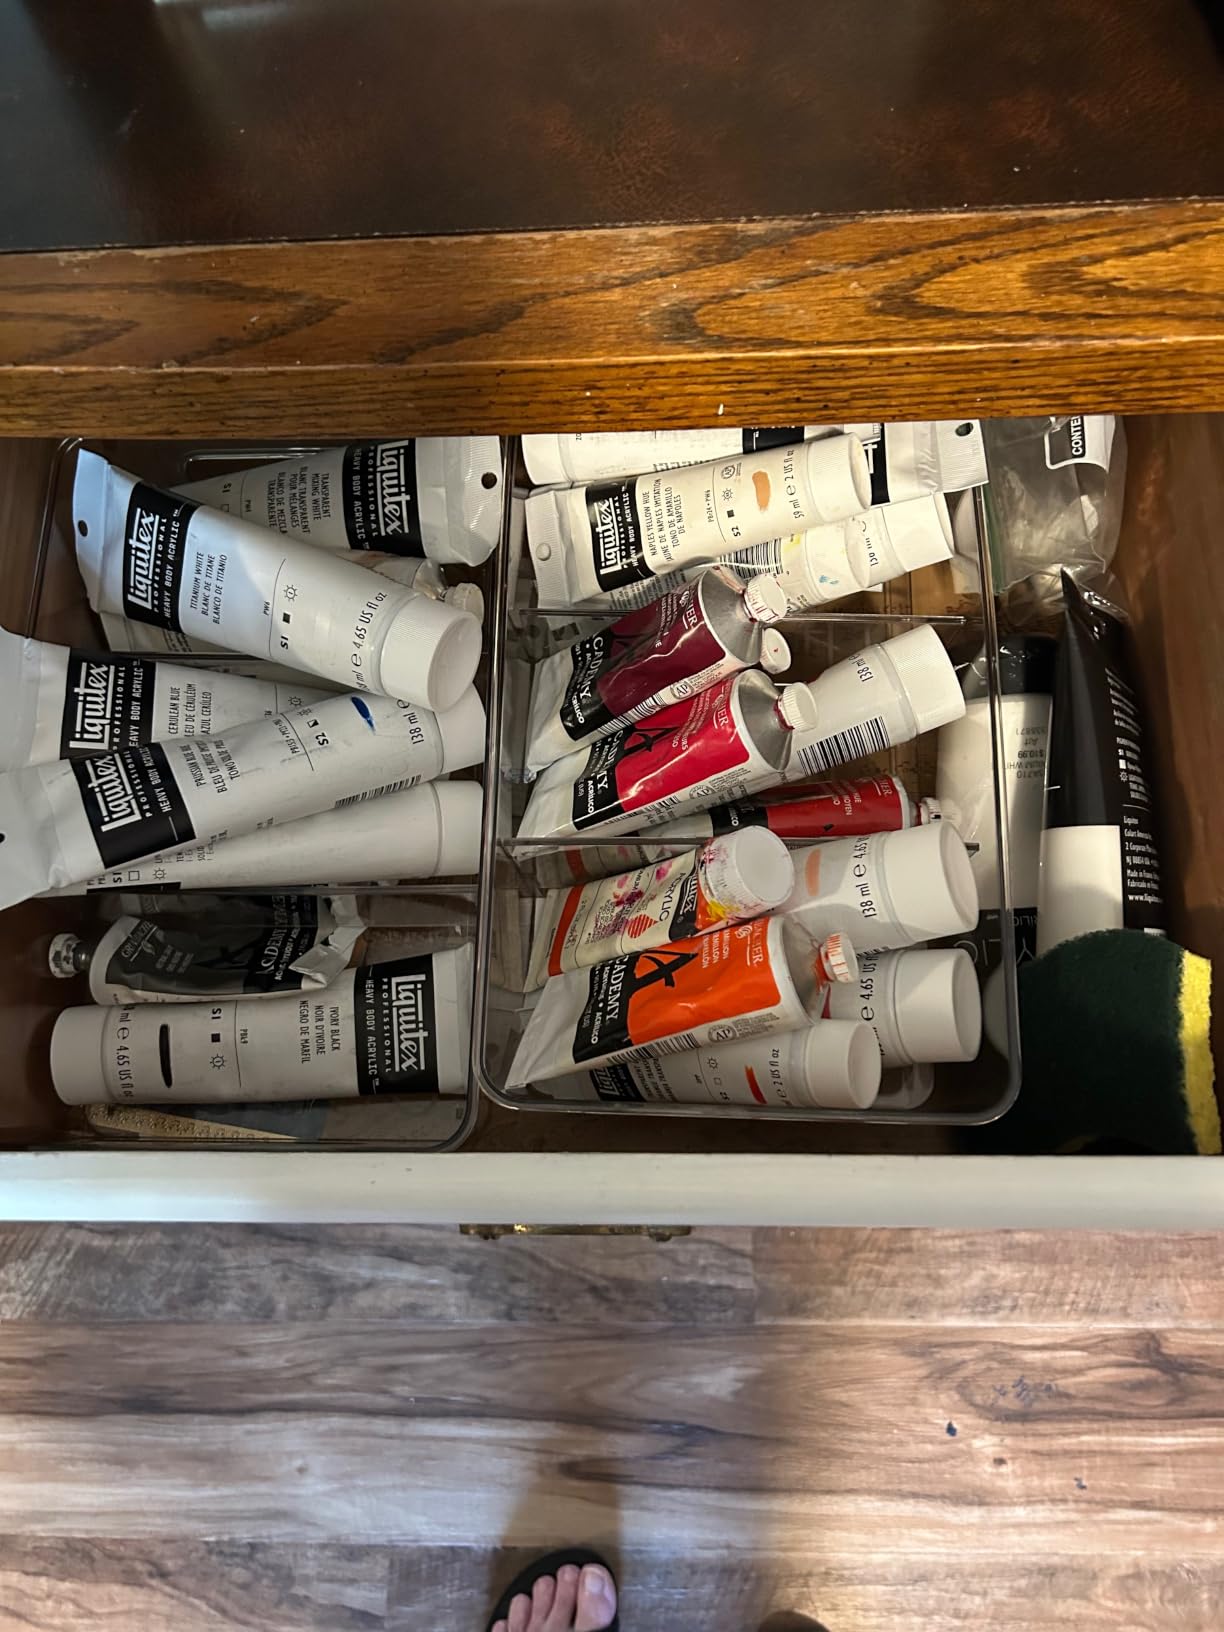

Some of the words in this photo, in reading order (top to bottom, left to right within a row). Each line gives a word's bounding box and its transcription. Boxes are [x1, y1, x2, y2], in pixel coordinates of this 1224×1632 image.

[300, 466, 308, 485] BLANC
[783, 464, 794, 475] US
[785, 474, 794, 482] 2
[276, 472, 285, 494] BLANCO
[289, 473, 298, 490] POUR
[312, 473, 321, 496] MIXING
[352, 475, 362, 496] BODY
[368, 446, 377, 537] PROFESSIONAL
[376, 440, 410, 536] Liquitex
[653, 478, 661, 507] IMITATION
[268, 479, 278, 527] TRANSPARENTE
[277, 497, 285, 506] DE
[321, 473, 331, 518] TRANSPARENT
[642, 491, 651, 505] HUE
[665, 486, 675, 518] AMARILLO
[789, 498, 801, 509] ml
[301, 487, 310, 533] TRANSPARENT
[312, 499, 321, 521] WHITE
[644, 508, 654, 532] YELLOW
[655, 508, 664, 532] NAPLES
[674, 494, 684, 524] NAPLES
[794, 510, 805, 519] 59
[668, 519, 676, 529] DE
[677, 525, 685, 534] DE
[731, 526, 741, 537] S2
[596, 497, 622, 575] Liquitex
[648, 532, 658, 557] NAPLES
[659, 534, 666, 543] DE
[669, 530, 680, 548] TONO
[127, 507, 160, 610] Liquitex
[154, 518, 168, 613] PROFESSIONAL
[195, 552, 204, 576] WHITE
[206, 554, 216, 579] TITANE
[217, 554, 228, 583] TITANIO
[164, 564, 174, 588] BODY
[206, 580, 212, 592] DE
[190, 577, 201, 609] TITANIUM
[216, 585, 223, 596] DE
[375, 592, 387, 602] oz
[161, 591, 172, 618] HEAVY
[200, 591, 210, 616] BLANC
[213, 597, 222, 625] BLANCO
[359, 611, 374, 625] US
[355, 626, 368, 649] 4.65
[579, 635, 604, 699] CADEMY
[857, 666, 874, 682] 138
[69, 662, 115, 750] Liquitex
[170, 687, 180, 704] BLUE
[130, 700, 141, 720] BODY
[168, 705, 180, 735] CERULEAN
[185, 714, 195, 725] DE
[403, 712, 418, 723] ml
[185, 725, 195, 737] LEU
[201, 715, 211, 735] AZUL
[409, 726, 424, 745] 138
[129, 725, 139, 748] EAVY
[315, 732, 329, 746] S2
[225, 761, 240, 780] TONO
[85, 753, 142, 832] Liquitex
[212, 774, 228, 793] BLEU
[154, 787, 172, 812] HEAVY
[853, 838, 868, 859] 4.65
[659, 872, 686, 922] ACRYLIC
[856, 882, 870, 898] ml
[859, 899, 878, 918] 138
[862, 960, 877, 973] US
[365, 979, 374, 1004] HEAVY
[606, 955, 629, 1020] CADEMY
[860, 978, 874, 1001] 4.65
[299, 1000, 309, 1024] NEGRO
[315, 1005, 324, 1023] NOIR
[330, 1007, 339, 1026] IVORY
[366, 1009, 376, 1031] BODY
[391, 974, 429, 1072] Liquitex
[300, 1026, 309, 1036] DE
[382, 977, 392, 1073] PROFESSIONAL
[301, 1038, 311, 1064] MARFIL
[315, 1025, 326, 1055] D'IVOIRE
[331, 1029, 341, 1051] BLACK
[116, 1045, 131, 1066] 4.65
[771, 1048, 780, 1058] oz
[118, 1069, 133, 1081] US
[770, 1067, 780, 1079] US
